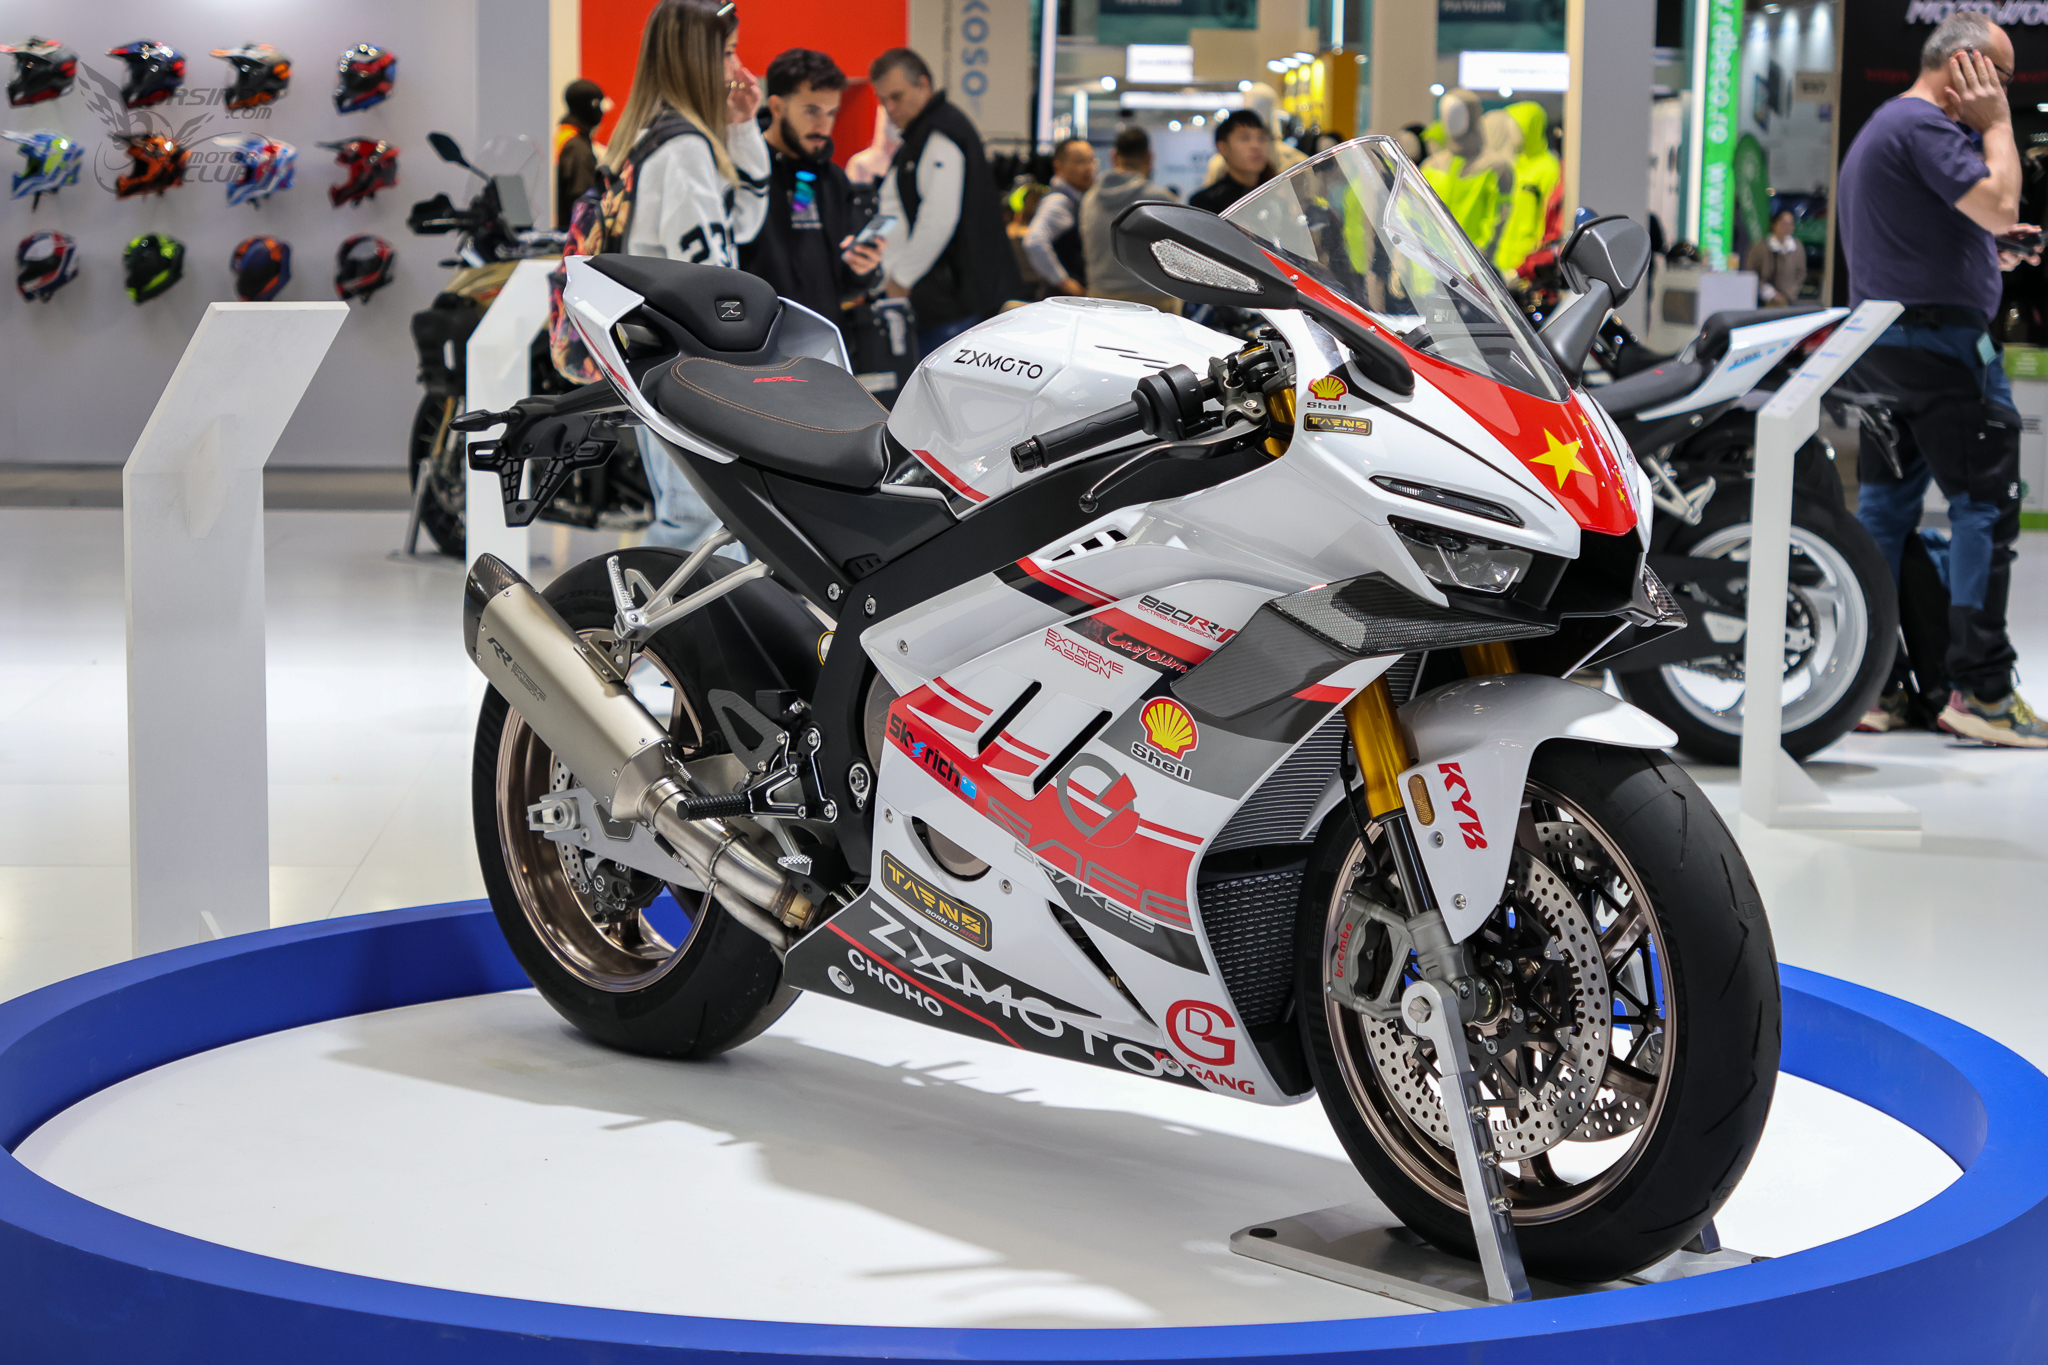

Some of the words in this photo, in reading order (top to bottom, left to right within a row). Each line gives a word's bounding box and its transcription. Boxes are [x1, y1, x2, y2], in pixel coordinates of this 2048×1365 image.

[954, 349, 1043, 379] ZXMOTO
[1306, 401, 1348, 411] Shell
[1138, 604, 1178, 626] EXTREME
[1178, 621, 1216, 641] PASSION
[487, 637, 513, 667] RR
[1044, 637, 1111, 679] PASSION
[1047, 628, 1124, 675] EXTREME
[1131, 742, 1191, 781] Shell
[1437, 762, 1488, 850] KYB
[1014, 841, 1156, 933] BRAKES
[925, 908, 948, 925] BORN
[948, 920, 960, 931] TO
[960, 928, 981, 942] RIDE
[1334, 922, 1353, 978] brembo
[848, 948, 943, 1017] CHOHO
[868, 900, 1165, 1077] ZXMOTO
